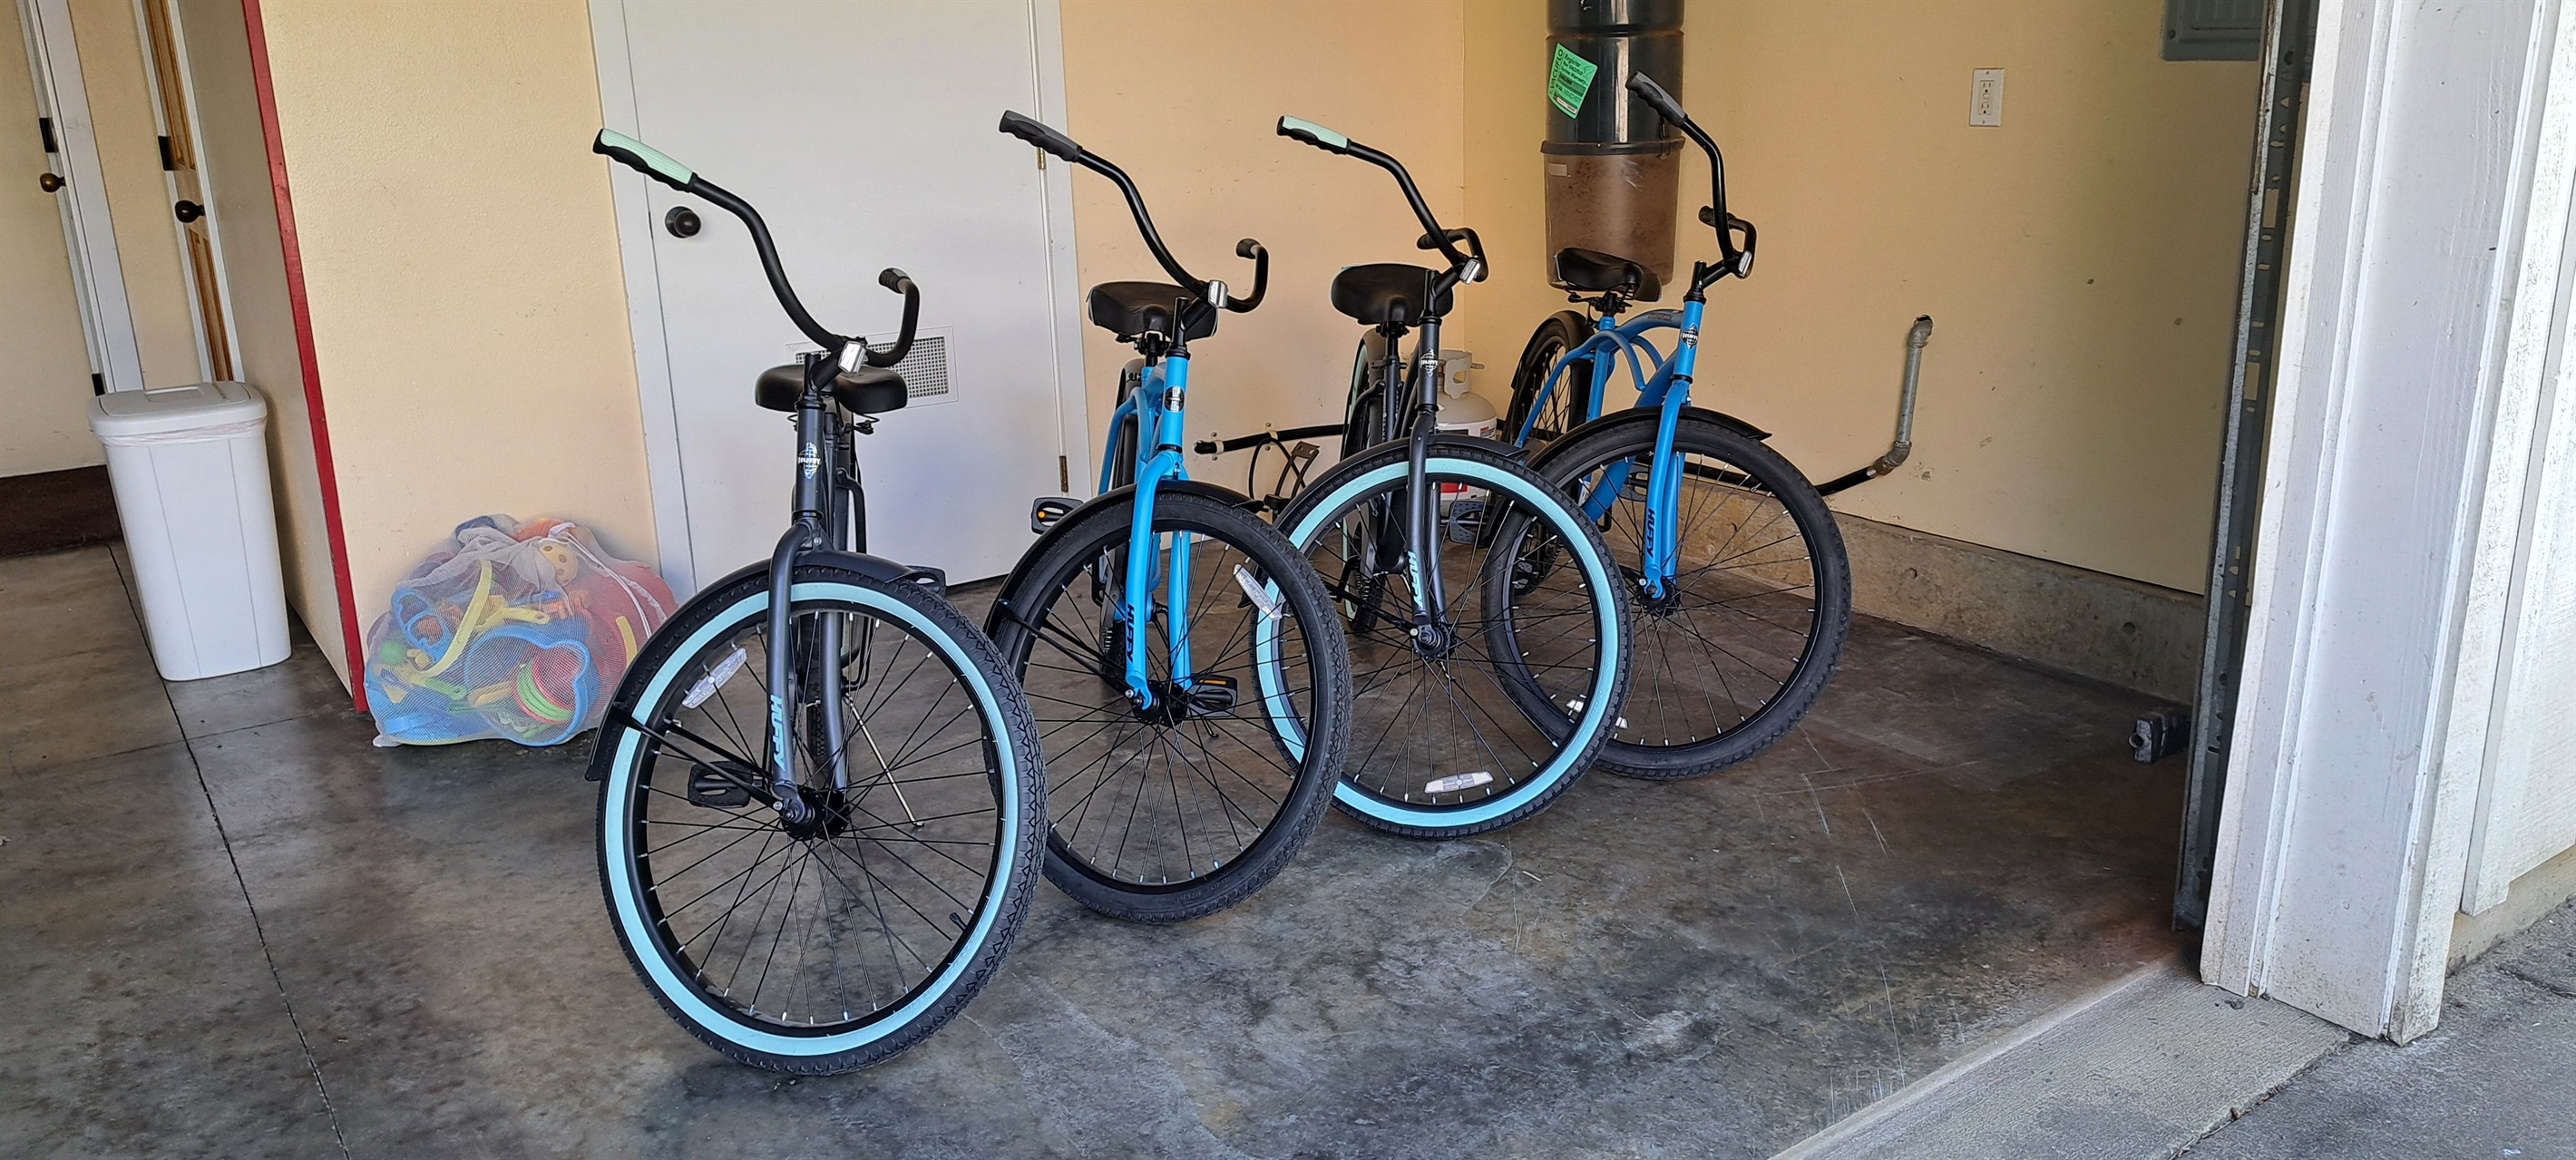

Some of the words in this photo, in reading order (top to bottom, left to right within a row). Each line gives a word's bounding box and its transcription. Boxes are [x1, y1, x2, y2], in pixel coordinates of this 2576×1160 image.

[1550, 49, 1564, 89] VACUFLO
[1646, 508, 1655, 559] HUFFY
[1407, 551, 1424, 609] HUFFY
[1127, 602, 1135, 664] HUFFY
[770, 694, 786, 772] HUFFY
